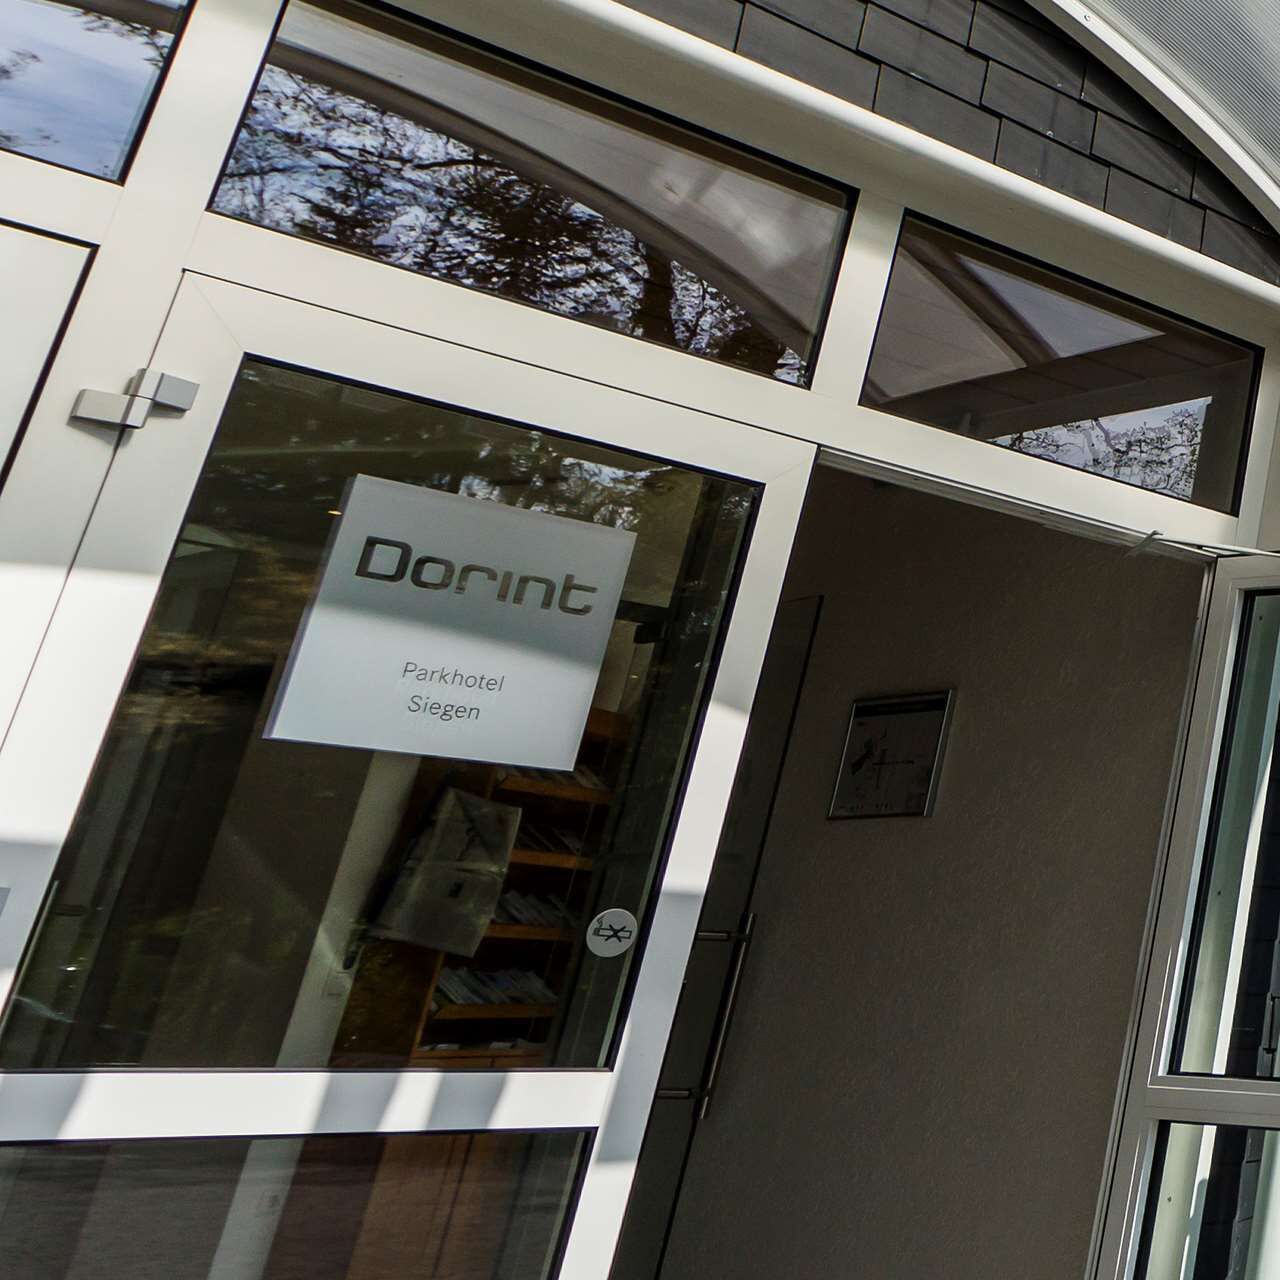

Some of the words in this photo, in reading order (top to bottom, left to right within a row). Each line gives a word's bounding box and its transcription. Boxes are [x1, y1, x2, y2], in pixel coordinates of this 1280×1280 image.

[355, 535, 598, 616] Dorint
[402, 662, 504, 692] Parkhotel
[407, 695, 480, 722] Siegen
